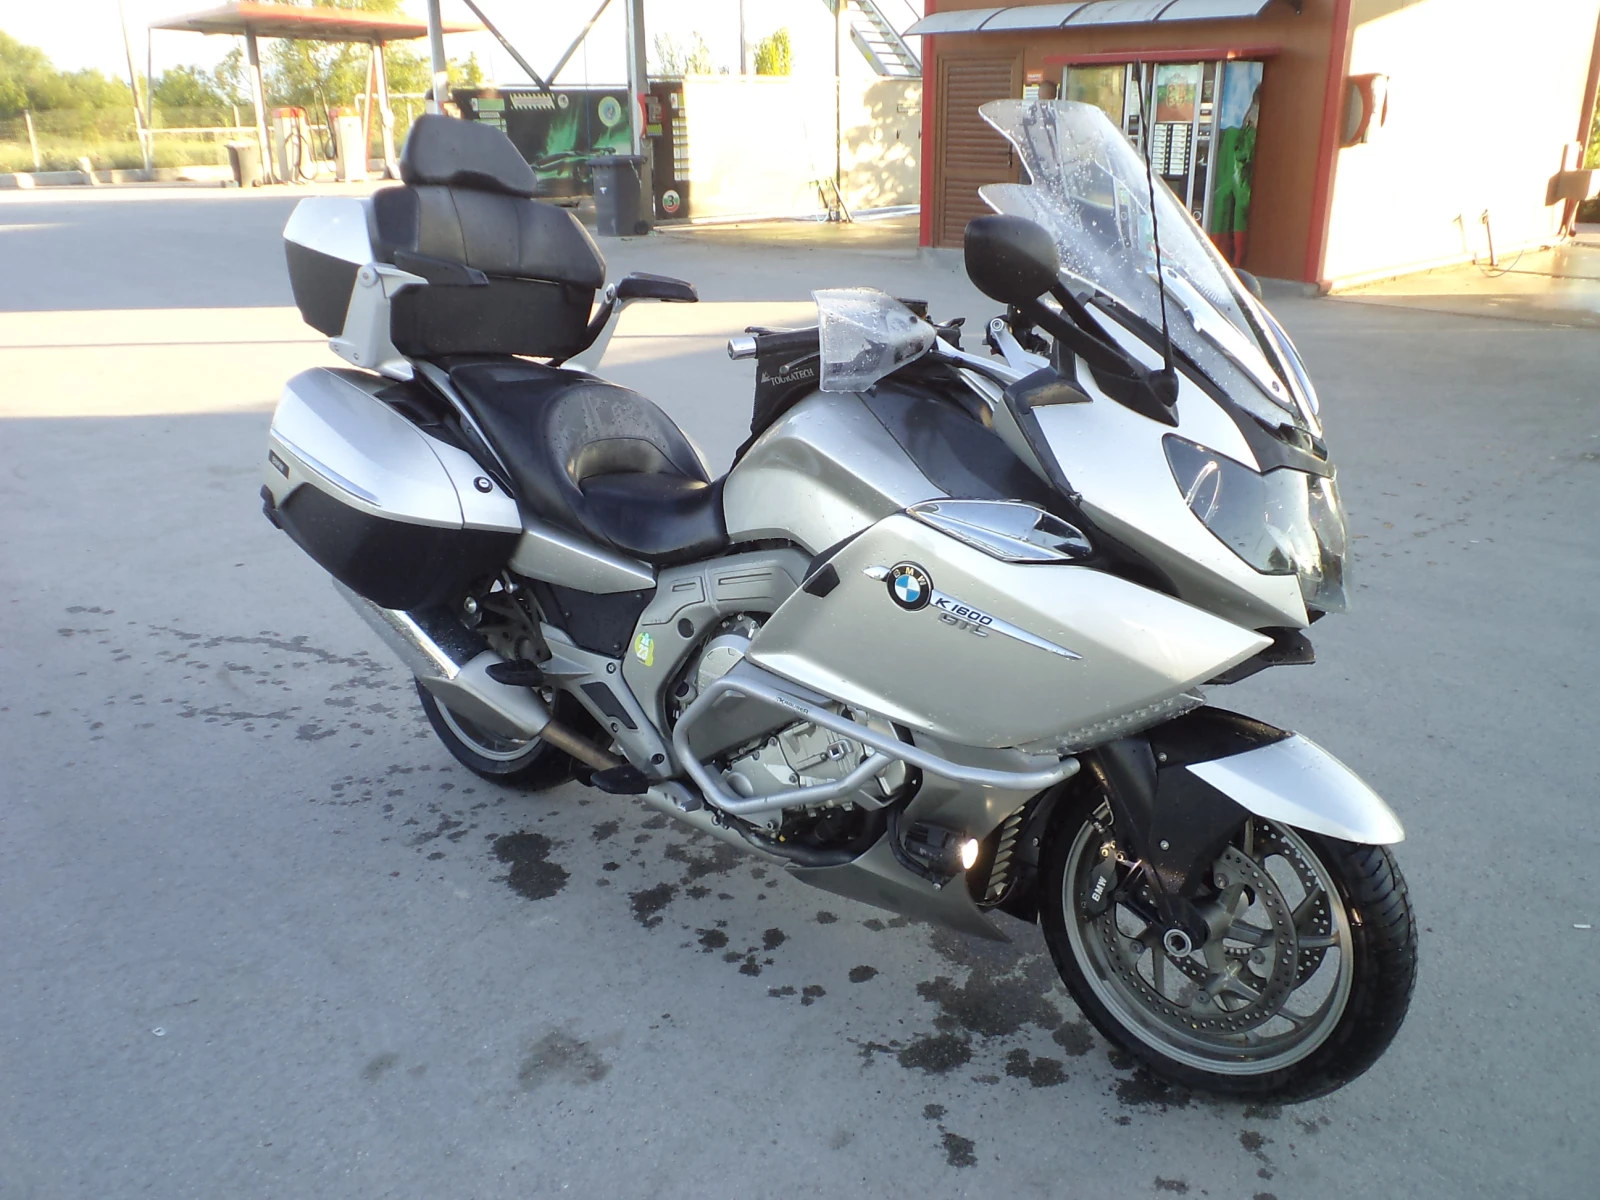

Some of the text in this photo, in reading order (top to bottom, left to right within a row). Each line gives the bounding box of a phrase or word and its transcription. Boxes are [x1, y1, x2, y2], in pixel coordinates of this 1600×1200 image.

[666, 195, 675, 207] 3
[893, 566, 927, 586] BMW
[935, 597, 993, 626] K 1600
[938, 610, 989, 638] GTL
[1091, 875, 1108, 903] BMW
